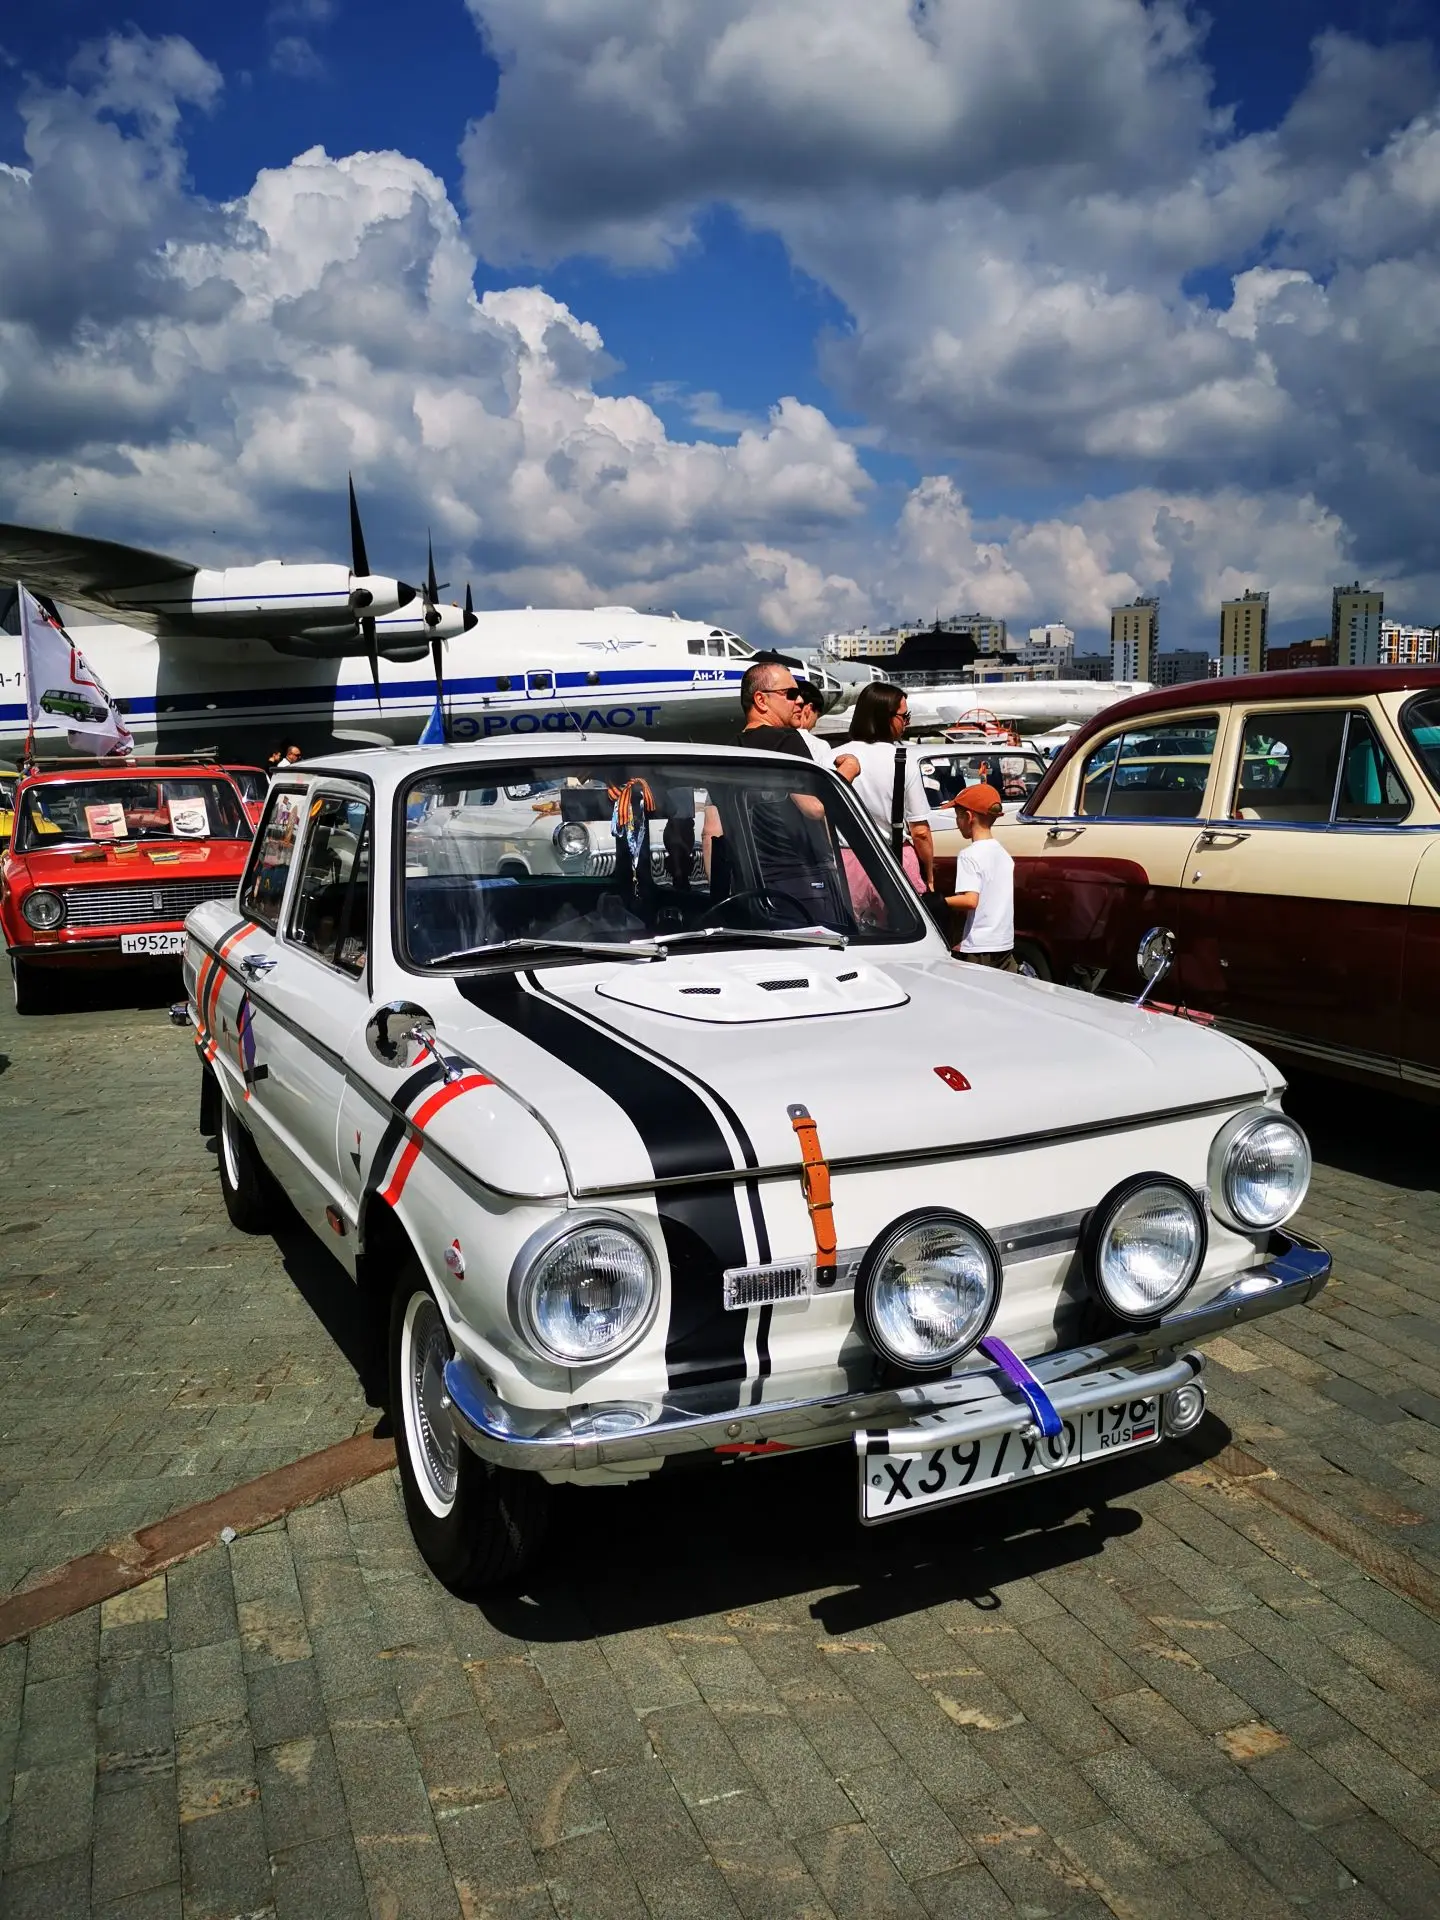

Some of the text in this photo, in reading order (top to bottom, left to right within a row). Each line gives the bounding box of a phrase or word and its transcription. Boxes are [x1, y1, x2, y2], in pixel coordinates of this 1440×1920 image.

[692, 670, 726, 681] Ан-12
[444, 706, 661, 738] ЭРОФЛОТ
[1100, 1428, 1131, 1449] RUS
